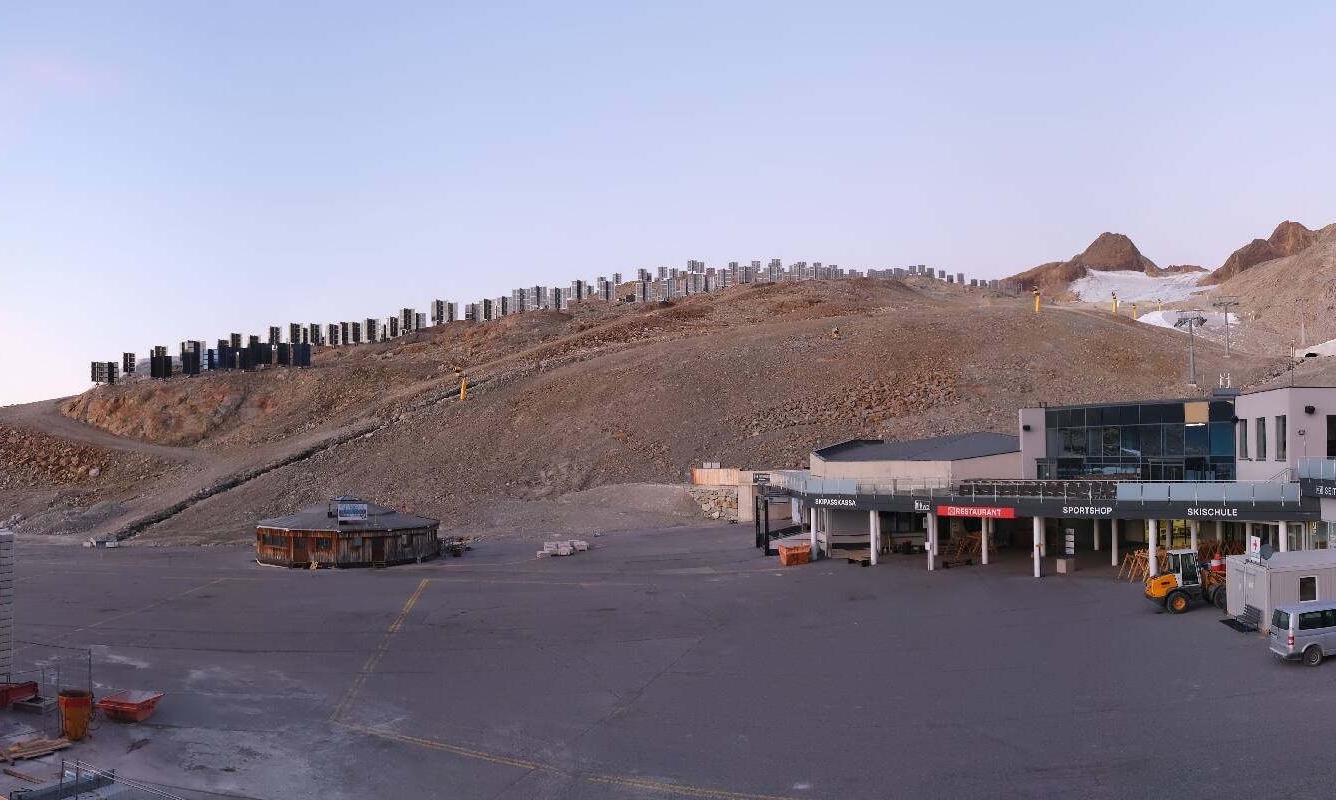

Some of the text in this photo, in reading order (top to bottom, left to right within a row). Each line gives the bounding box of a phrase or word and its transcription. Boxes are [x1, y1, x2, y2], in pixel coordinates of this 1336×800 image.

[955, 507, 1002, 516] RESTAURANT
[1062, 506, 1113, 515] SPORTSHOP
[1187, 508, 1238, 517] SKISCHULE
